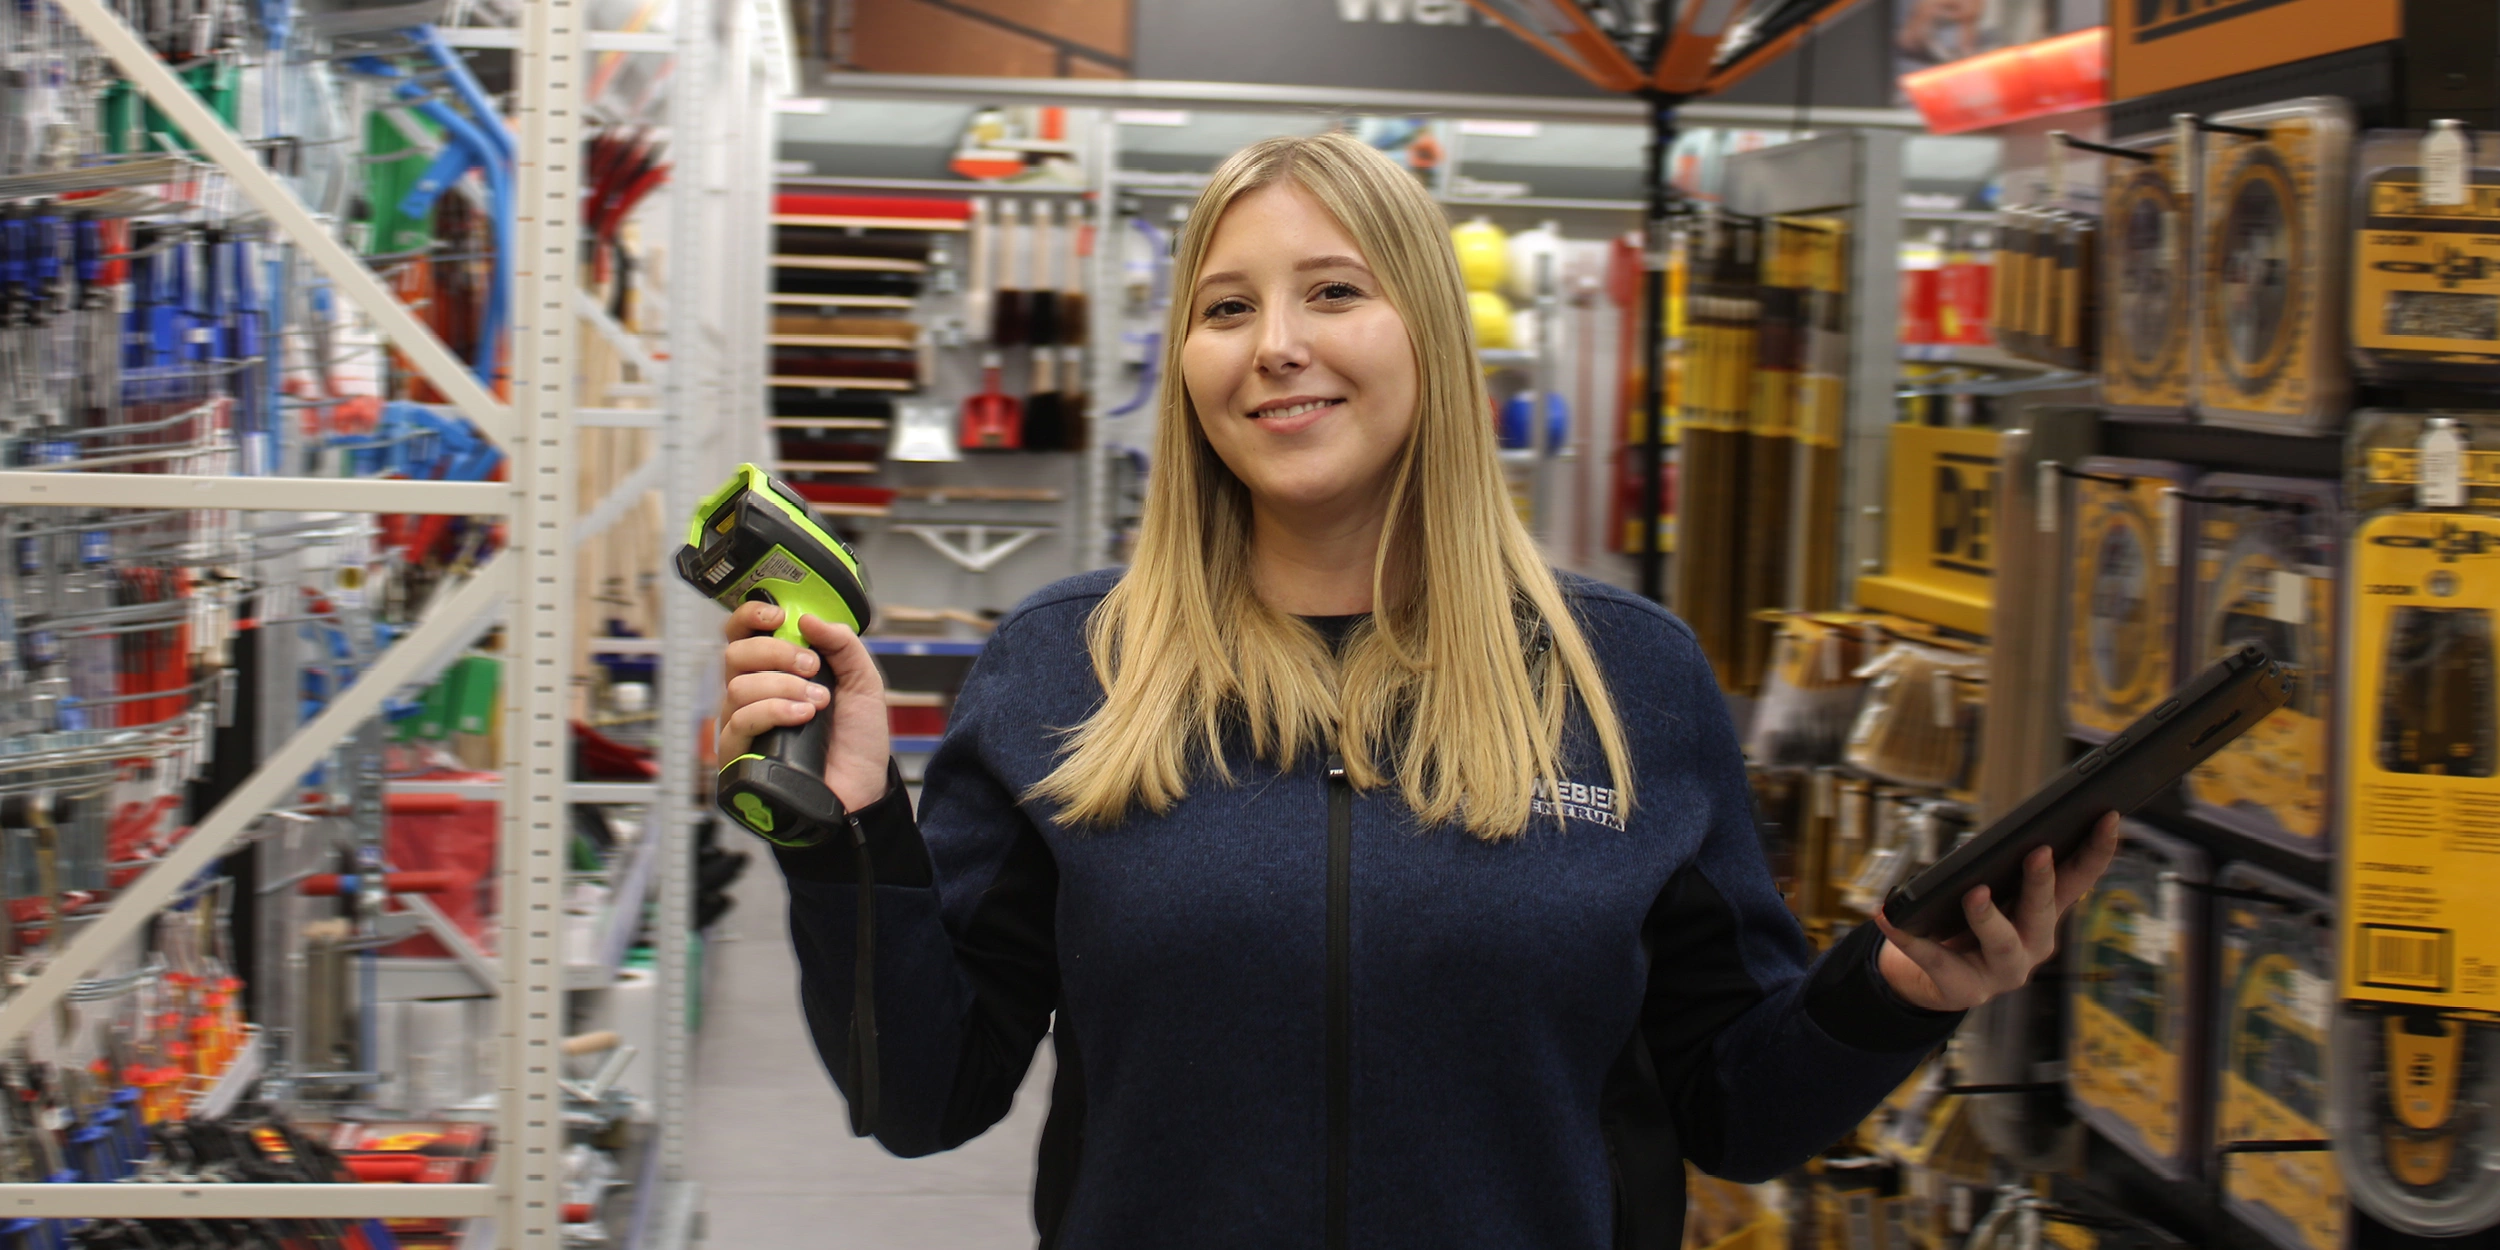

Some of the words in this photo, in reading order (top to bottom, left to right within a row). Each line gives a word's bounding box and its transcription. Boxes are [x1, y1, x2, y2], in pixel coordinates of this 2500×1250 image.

[1933, 466, 2000, 561] DE
[1530, 777, 1621, 811] WEBER
[1530, 799, 1626, 832] ENTRUM
